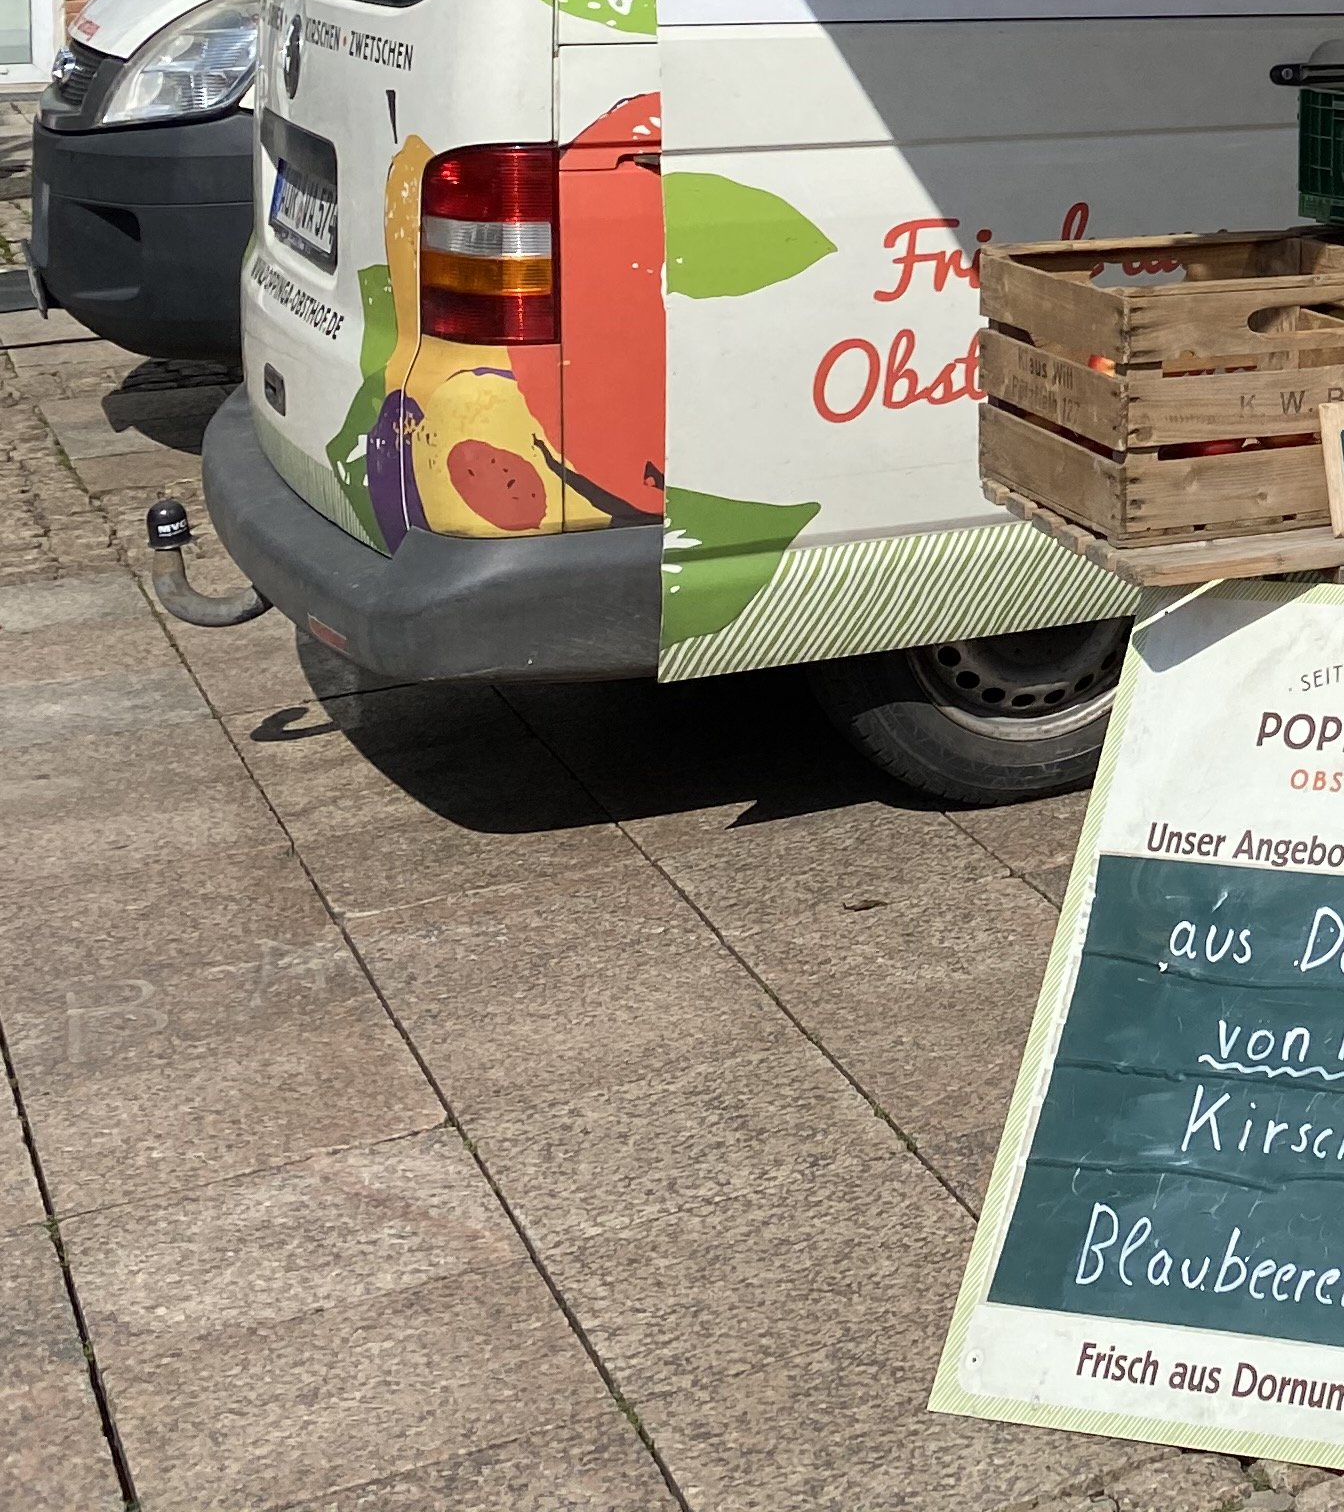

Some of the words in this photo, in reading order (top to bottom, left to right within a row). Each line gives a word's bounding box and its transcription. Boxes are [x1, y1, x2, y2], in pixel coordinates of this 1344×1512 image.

[348, 29, 415, 72] ZWETSCHEN
[1299, 663, 1344, 692] SEIT
[1145, 821, 1226, 860] Unser
[1168, 918, 1254, 965] aus
[1215, 1018, 1311, 1063] von
[1075, 1340, 1160, 1386] Frisch
[1168, 1360, 1221, 1396] aus
